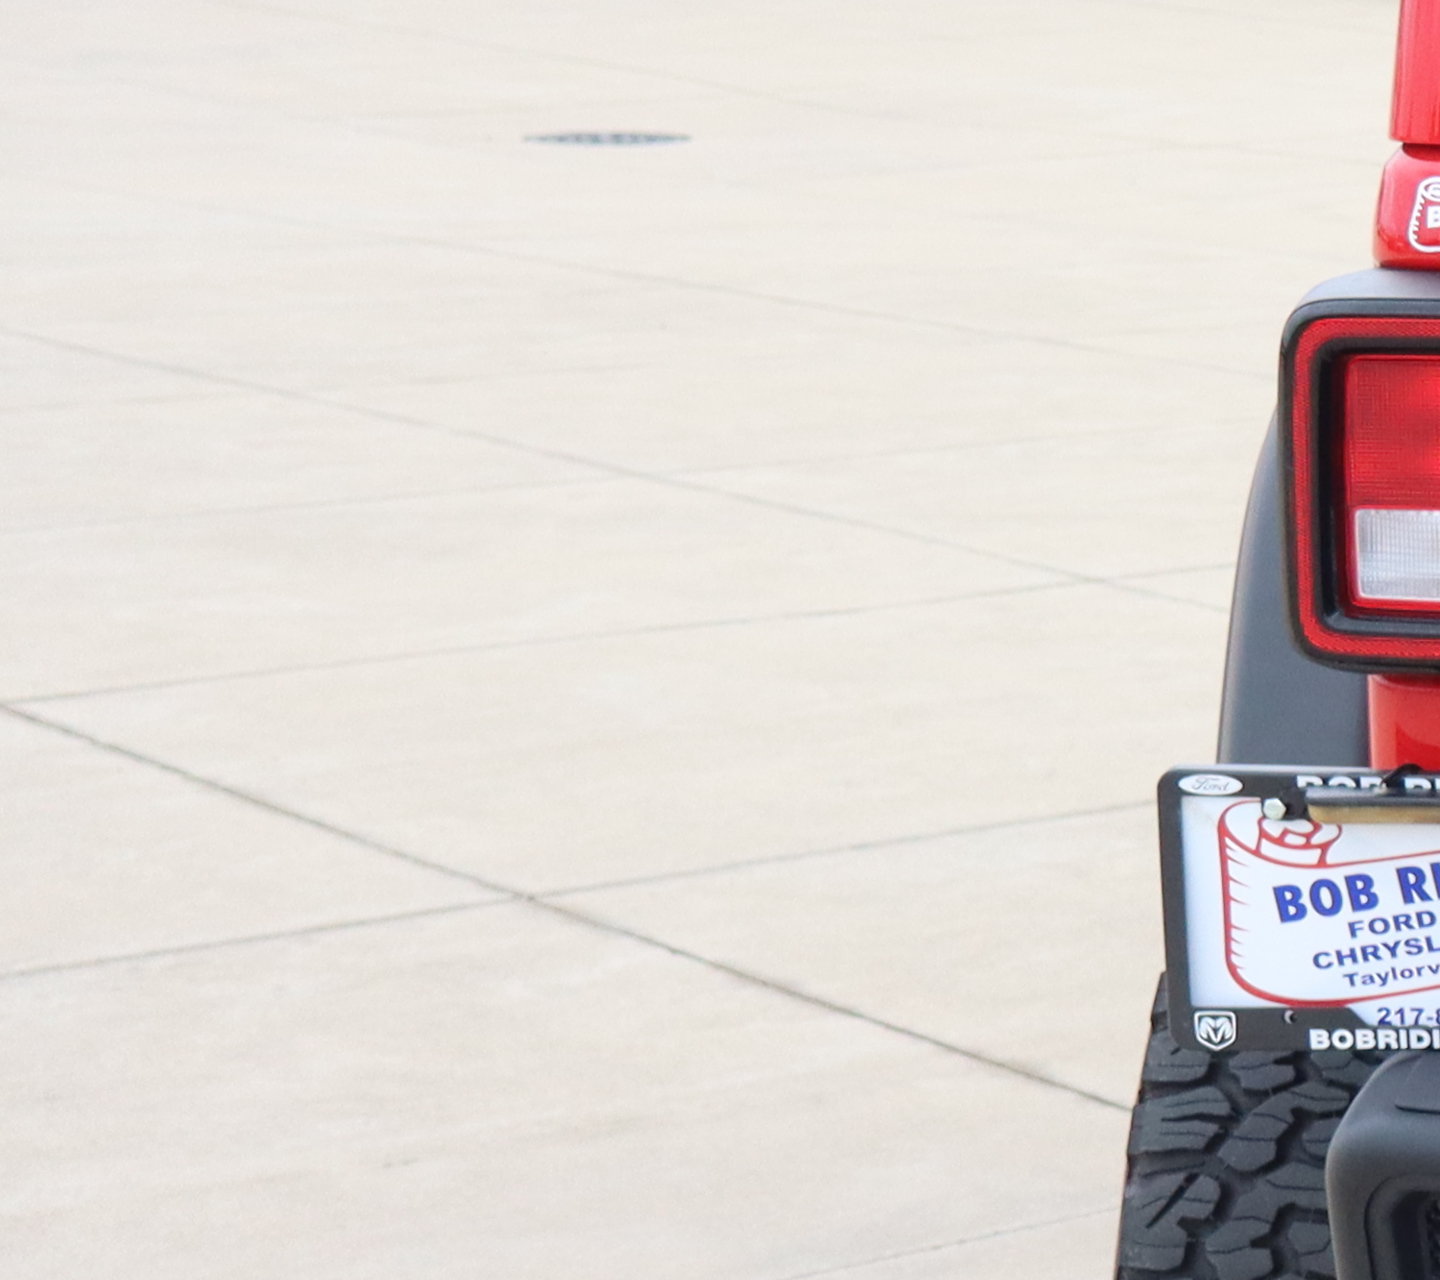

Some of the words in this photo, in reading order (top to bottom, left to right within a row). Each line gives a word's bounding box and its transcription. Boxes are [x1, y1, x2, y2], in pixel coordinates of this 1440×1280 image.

[1191, 776, 1229, 792] Ford
[1273, 873, 1379, 924] BOB
[1347, 910, 1437, 939] FORD
